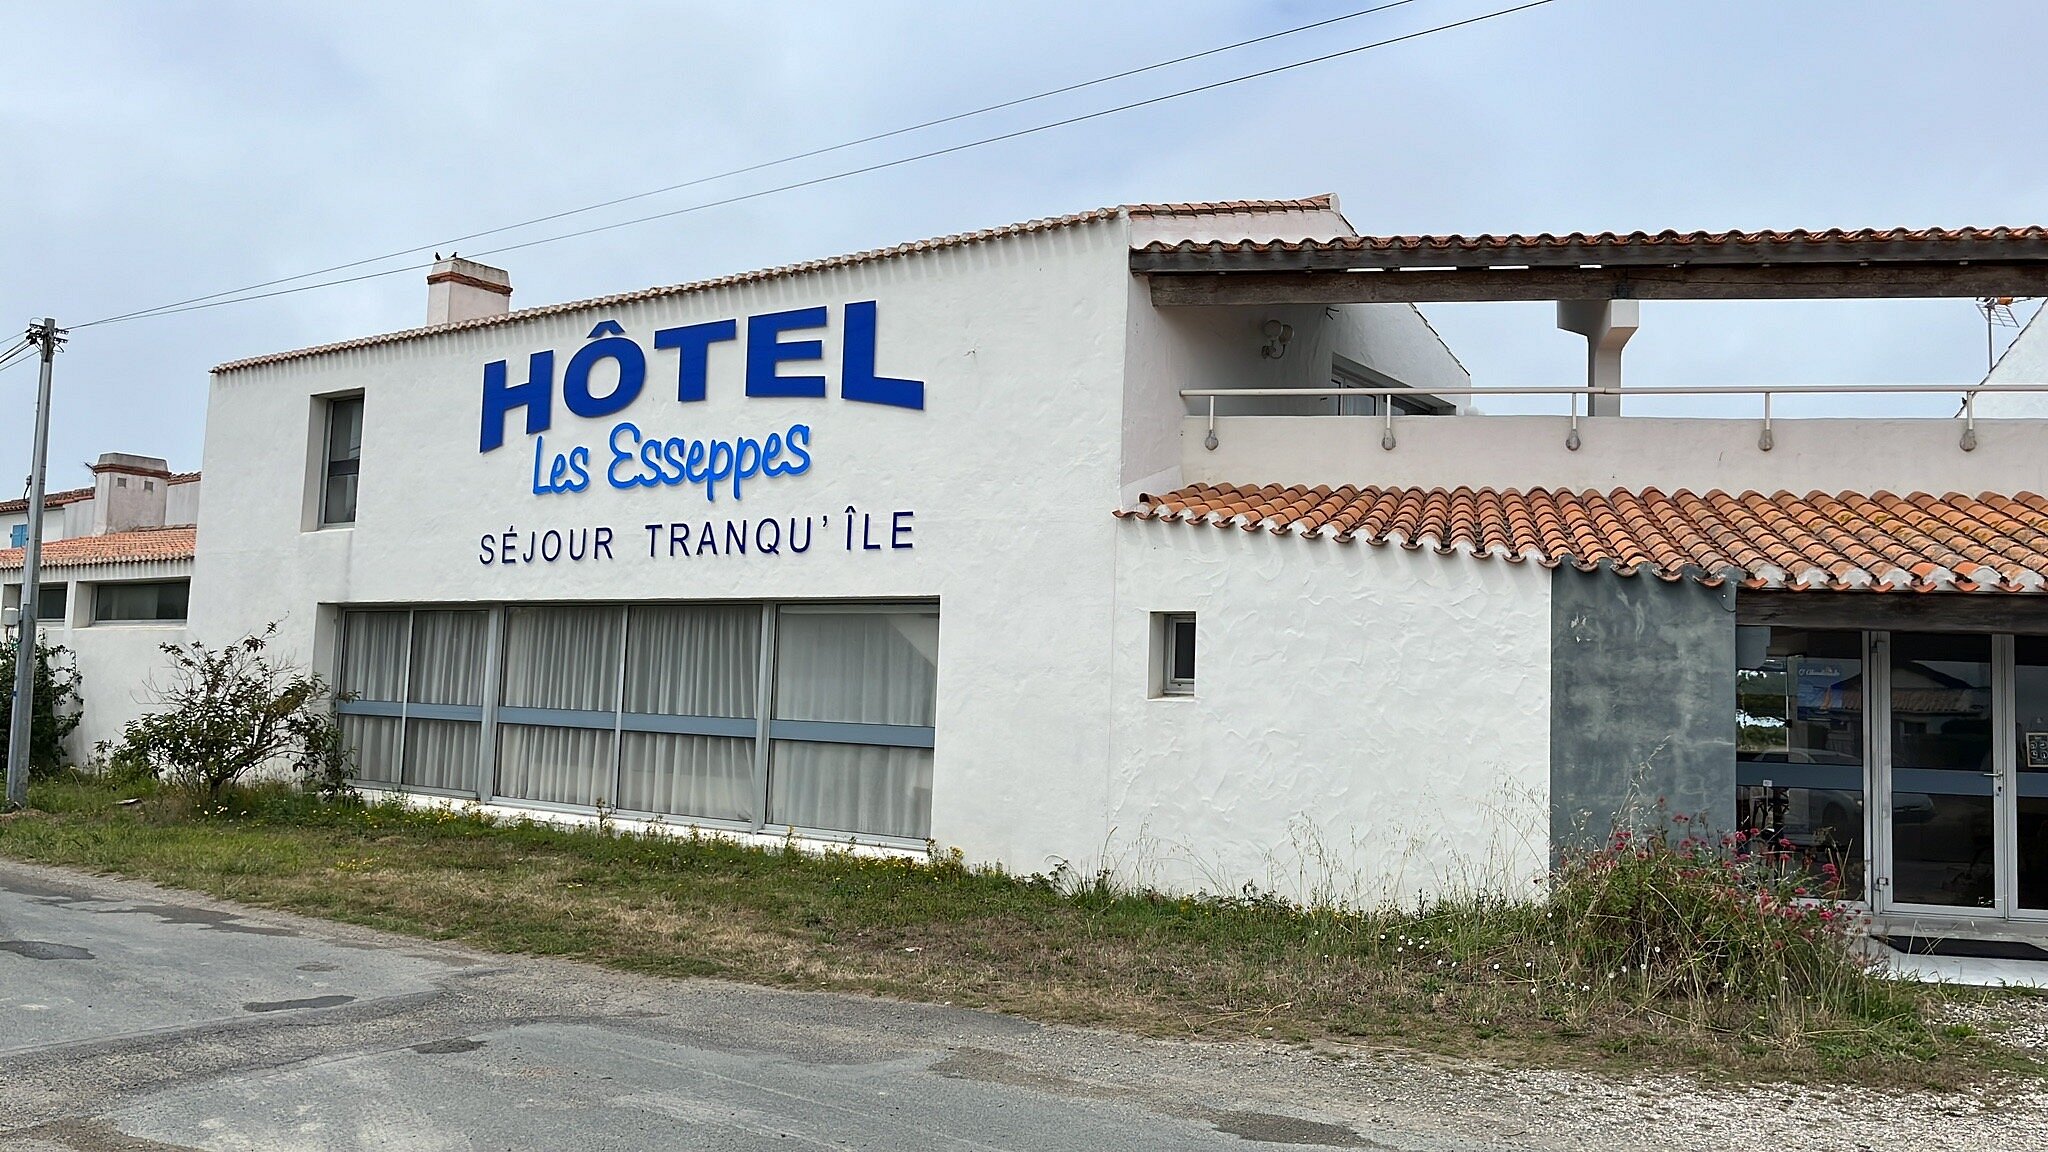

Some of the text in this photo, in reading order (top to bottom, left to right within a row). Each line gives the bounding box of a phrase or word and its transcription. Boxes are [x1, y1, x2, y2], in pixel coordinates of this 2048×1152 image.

[480, 300, 925, 454] HÔTEL
[532, 422, 811, 502] Les Esseppes
[479, 525, 614, 566] SÉJOUR
